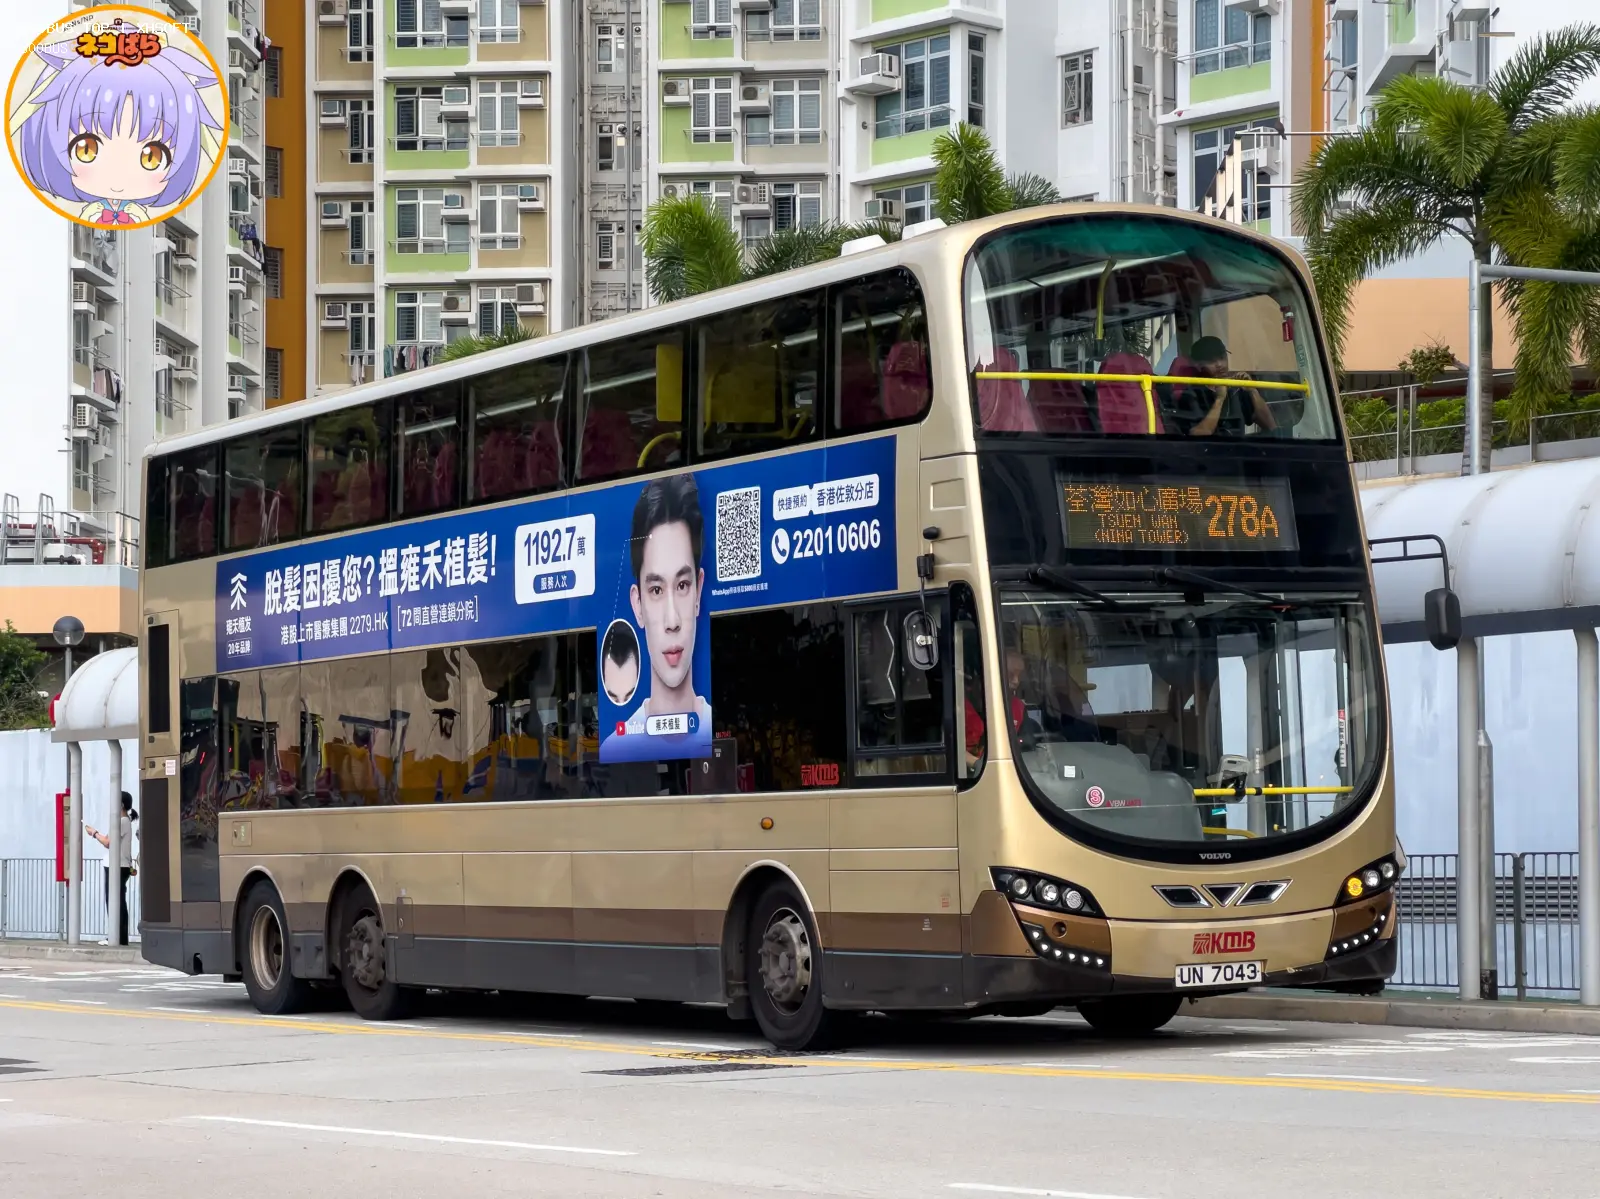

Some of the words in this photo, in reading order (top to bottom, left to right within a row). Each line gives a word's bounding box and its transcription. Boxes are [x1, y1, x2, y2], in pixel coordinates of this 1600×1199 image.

[777, 493, 808, 512] 快捷預約
[816, 480, 875, 508] 香港佐敦分店
[1097, 513, 1142, 528] TSUEN
[1151, 514, 1178, 529] WAN
[1204, 495, 1280, 537] 278A
[792, 526, 833, 559] 2201
[837, 518, 881, 553] 0606
[540, 574, 568, 591] 服務人次
[811, 763, 840, 785] KMB
[1199, 852, 1232, 860] VOLVO
[1210, 930, 1256, 954] KMB
[1179, 966, 1204, 985] UN
[1211, 963, 1258, 983] 7043
